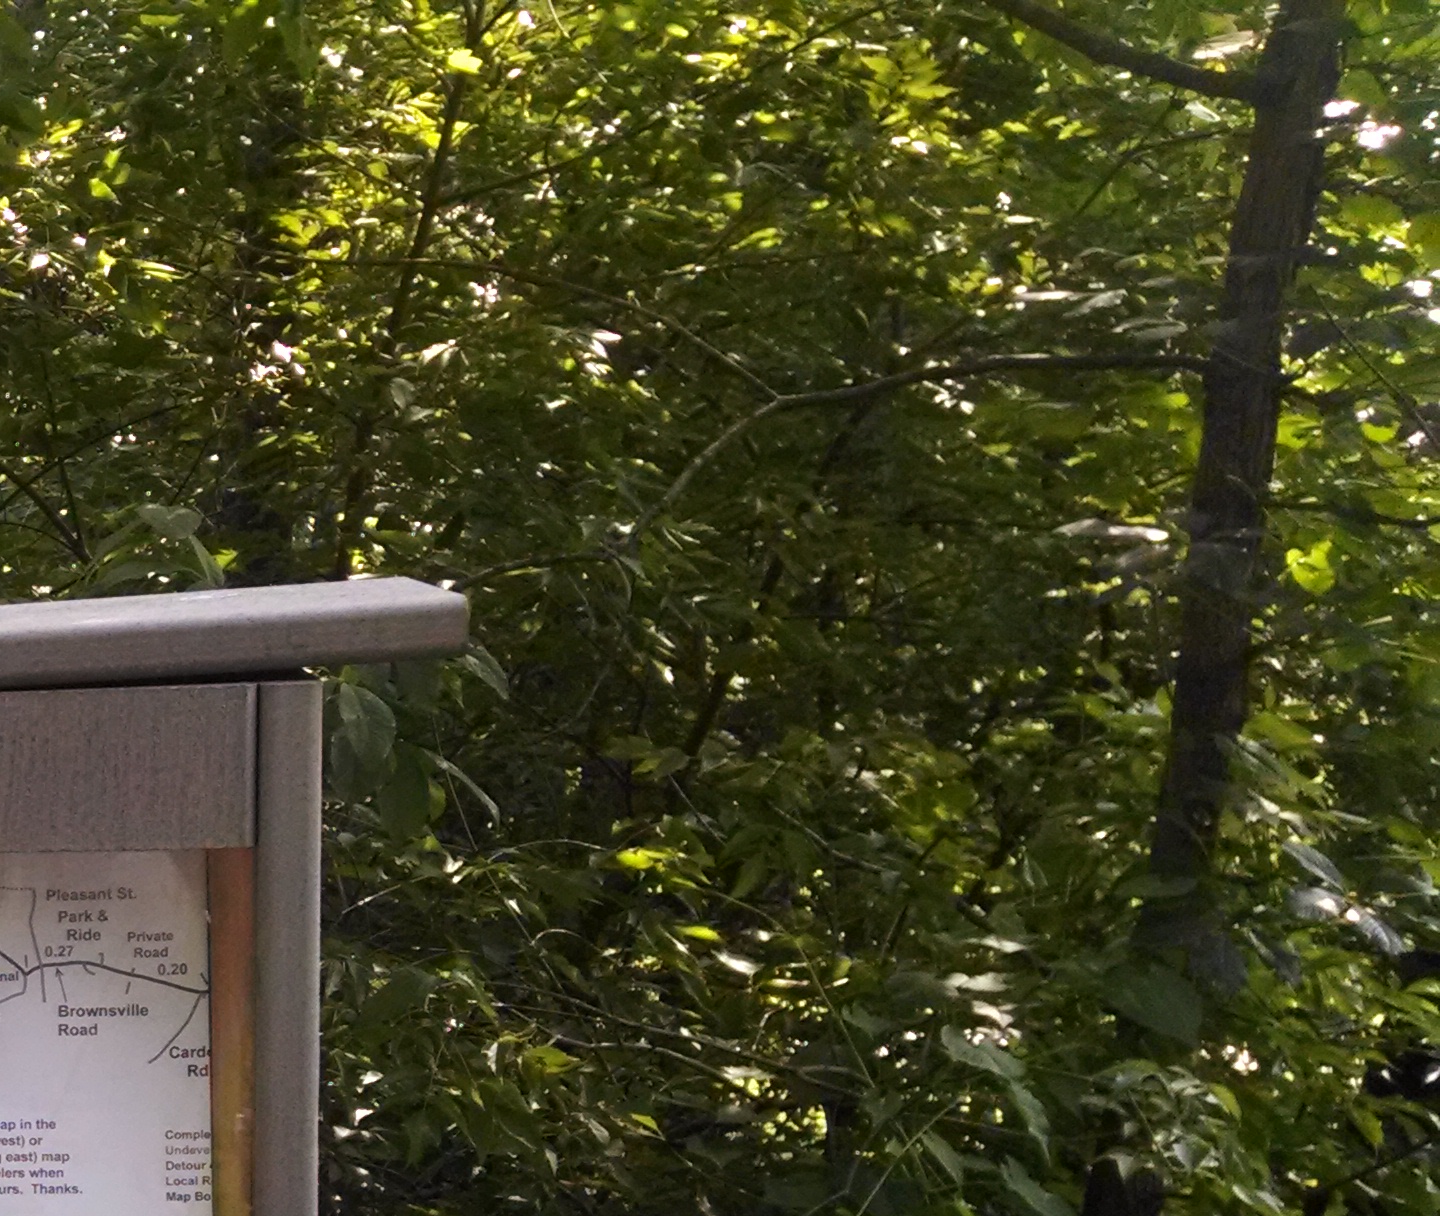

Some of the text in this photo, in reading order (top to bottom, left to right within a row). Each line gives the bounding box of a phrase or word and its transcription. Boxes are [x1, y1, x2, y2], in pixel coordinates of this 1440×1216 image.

[46, 887, 137, 900] Pleasant St.
[58, 910, 109, 923] Park &
[66, 929, 101, 942] Ride
[127, 931, 174, 942] Private
[45, 946, 74, 958] 0.27
[133, 947, 169, 958] Road
[157, 964, 188, 976] 0.20
[58, 1004, 149, 1018] Brownsville
[58, 1024, 98, 1036] Road
[188, 1064, 209, 1077] Rd
[20, 1118, 32, 1129] in
[36, 1118, 56, 1130] the
[29, 1137, 43, 1146] or
[5, 1151, 37, 1164] east)
[41, 1153, 70, 1165] map
[165, 1161, 207, 1171] Detour
[29, 1168, 64, 1178] when
[165, 1176, 199, 1186] Local
[31, 1183, 83, 1194] Thanks.
[166, 1192, 191, 1203] Map
